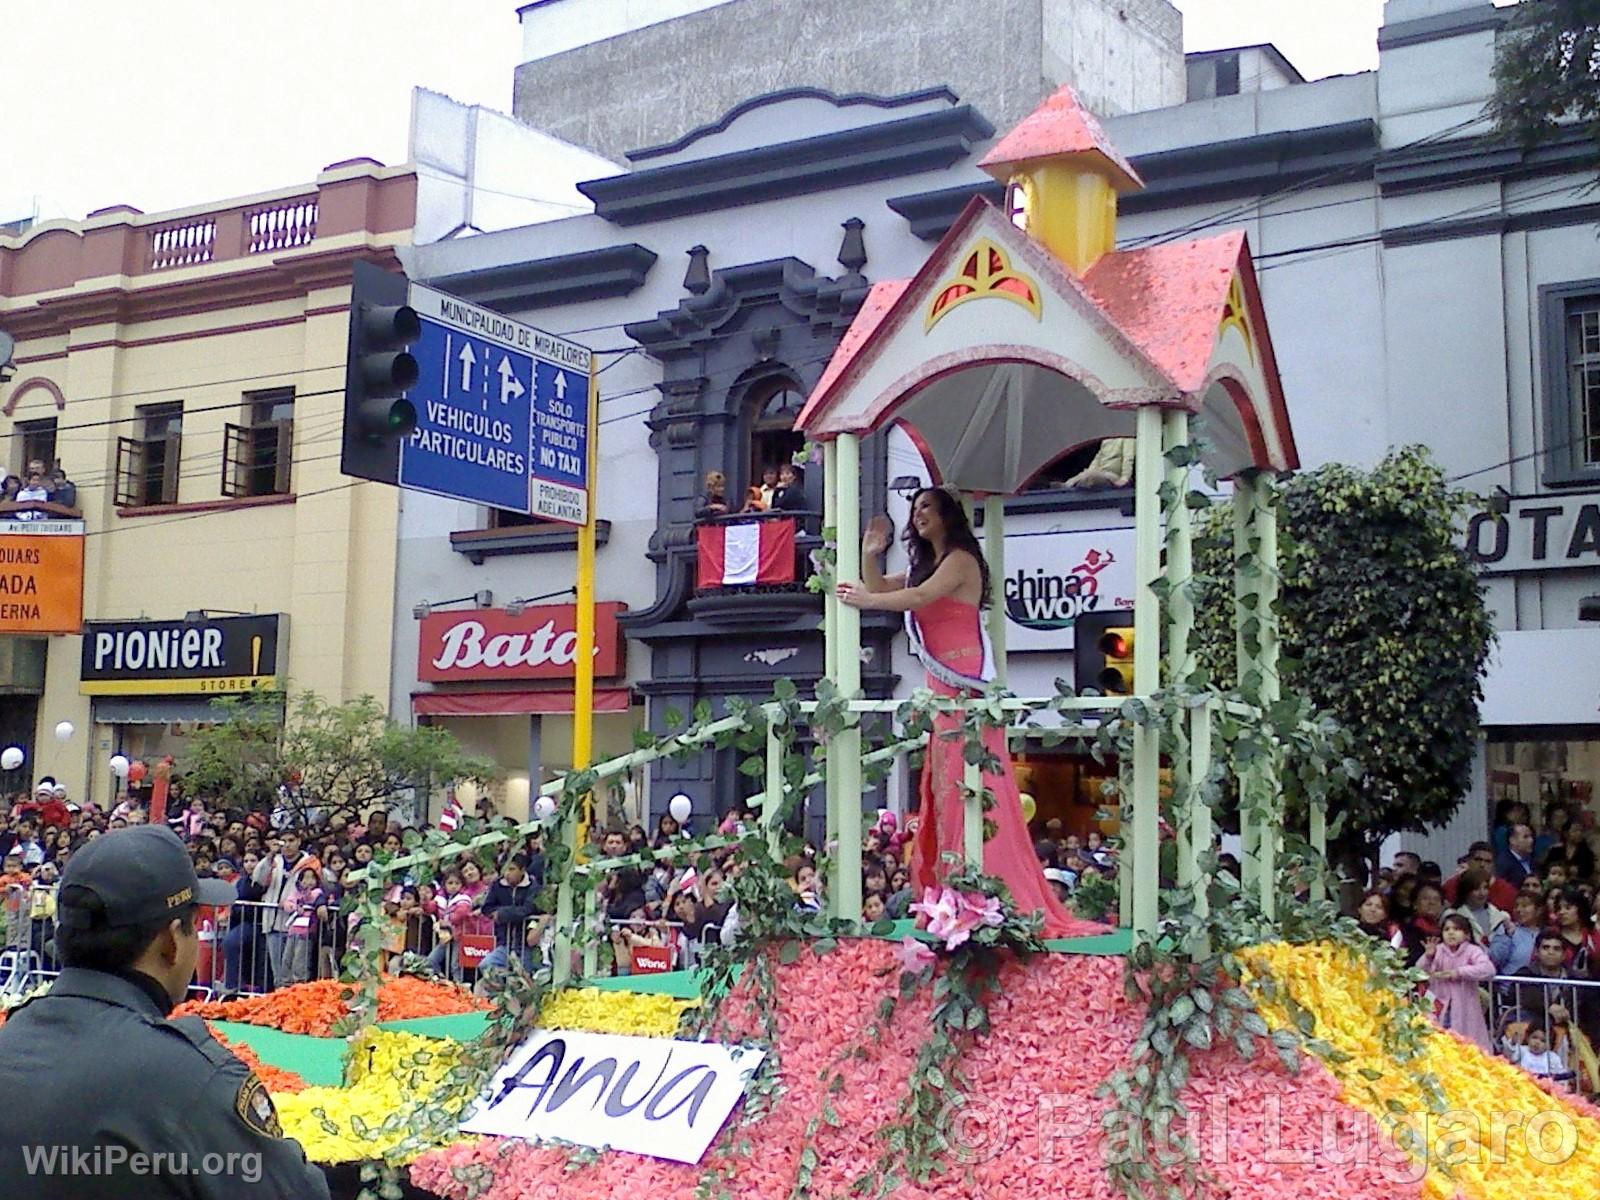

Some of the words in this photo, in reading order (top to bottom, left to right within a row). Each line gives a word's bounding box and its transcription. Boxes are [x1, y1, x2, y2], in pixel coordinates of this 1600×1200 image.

[440, 299, 514, 341] MUNICIPALIDAD
[517, 330, 531, 348] DE
[534, 335, 590, 370] MIRAFLORES
[548, 400, 573, 418] SOLO
[427, 400, 512, 444] VEHICULOS
[536, 411, 585, 438] TRANSPORTE
[542, 430, 578, 451] PUBLICO
[410, 428, 525, 475] PARTICULARES
[540, 447, 556, 468] NO
[557, 451, 581, 476] TAXI
[539, 485, 580, 505] PROHIBIDO
[537, 500, 582, 520] ADELANTAR
[0, 548, 40, 564] OUARS
[0, 575, 37, 595] ADA
[1005, 568, 1082, 599] china
[1, 604, 41, 619] ERNA
[432, 619, 600, 670] Bata
[200, 679, 246, 691] STORE
[166, 887, 193, 908] PERU
